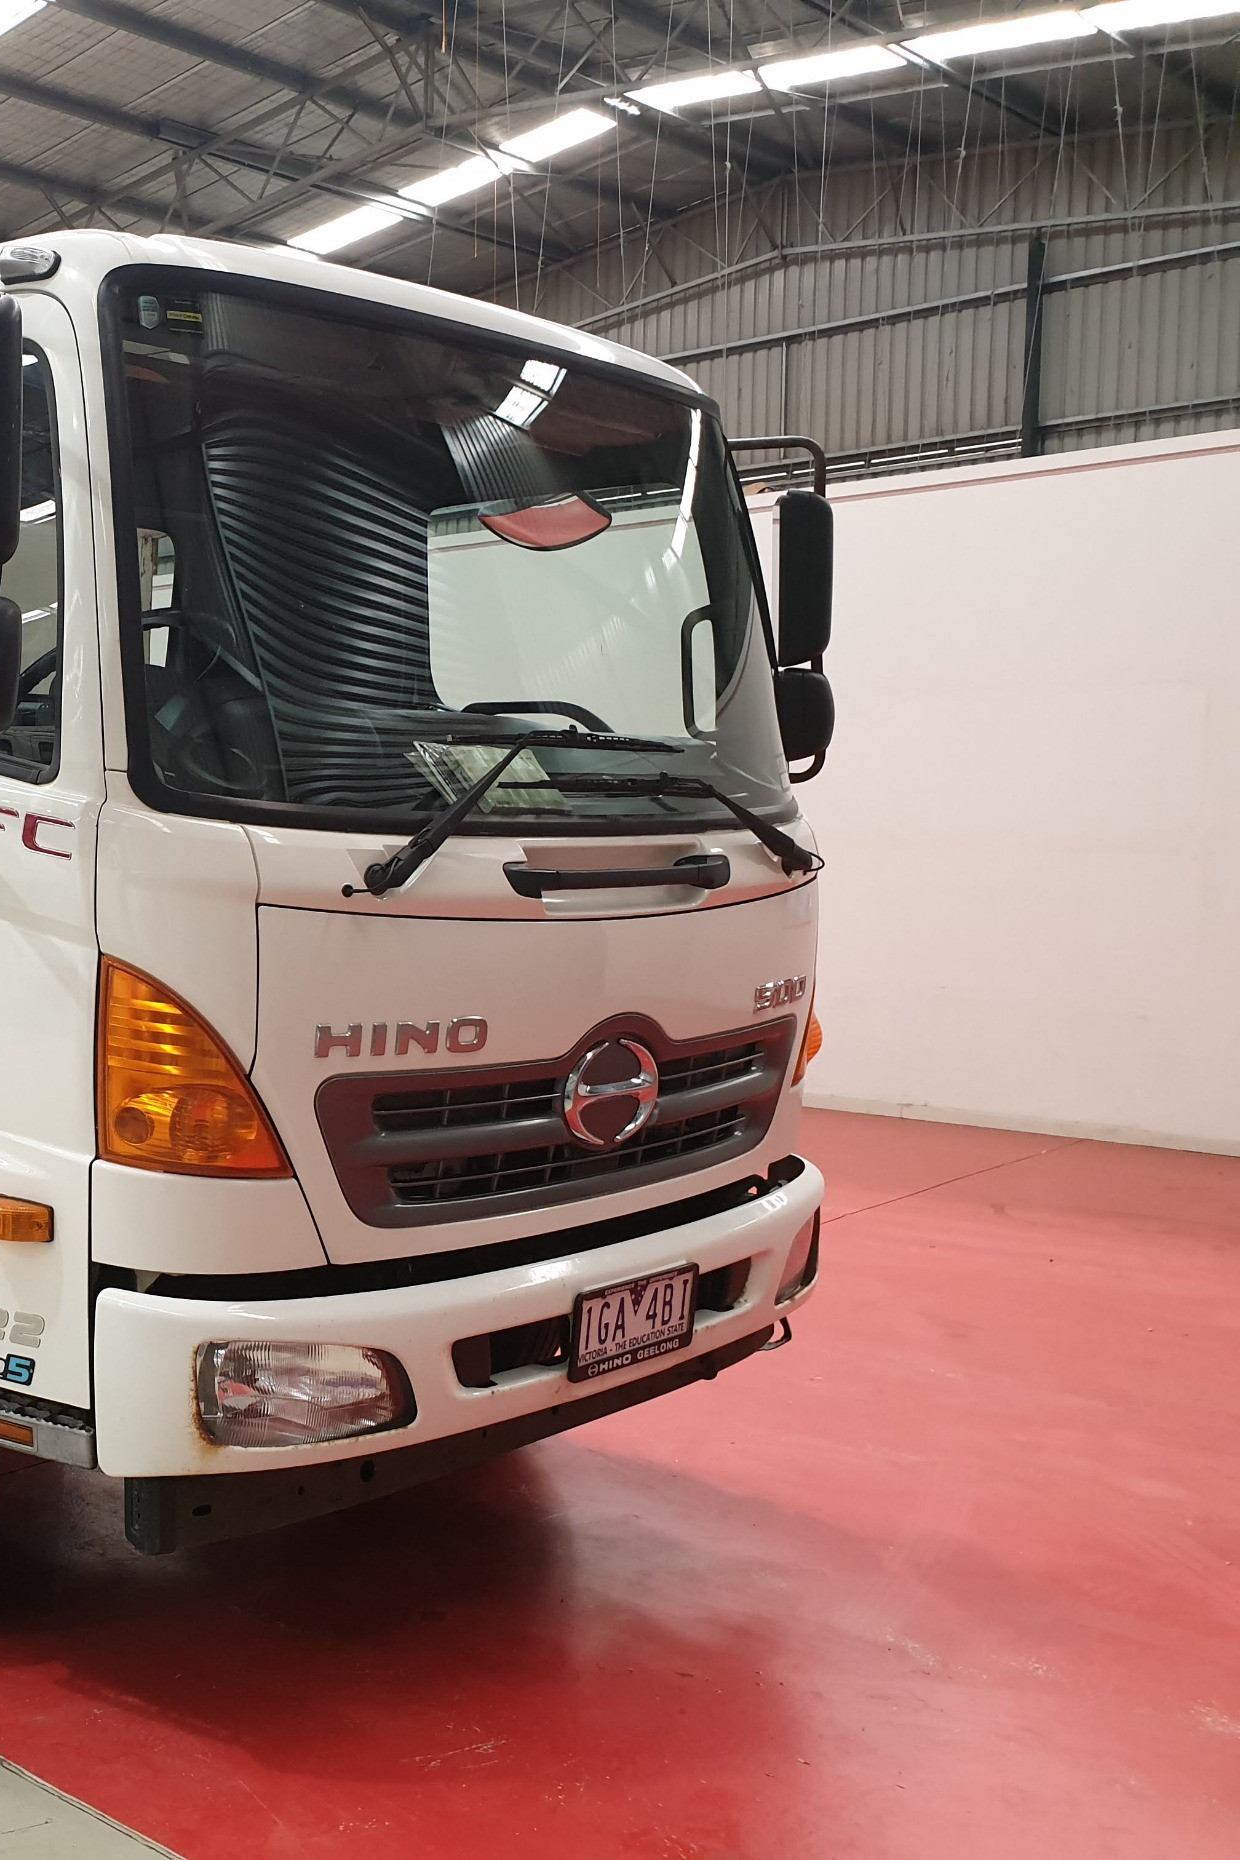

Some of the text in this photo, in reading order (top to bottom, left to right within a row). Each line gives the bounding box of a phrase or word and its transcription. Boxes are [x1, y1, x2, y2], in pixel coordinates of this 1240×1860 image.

[753, 975, 807, 1014] 500
[314, 1015, 488, 1058] HINO
[614, 1341, 627, 1352] THE
[628, 1328, 666, 1348] EDUCATION
[666, 1322, 685, 1336] STATE
[599, 1339, 679, 1372] HINO GEELONG
